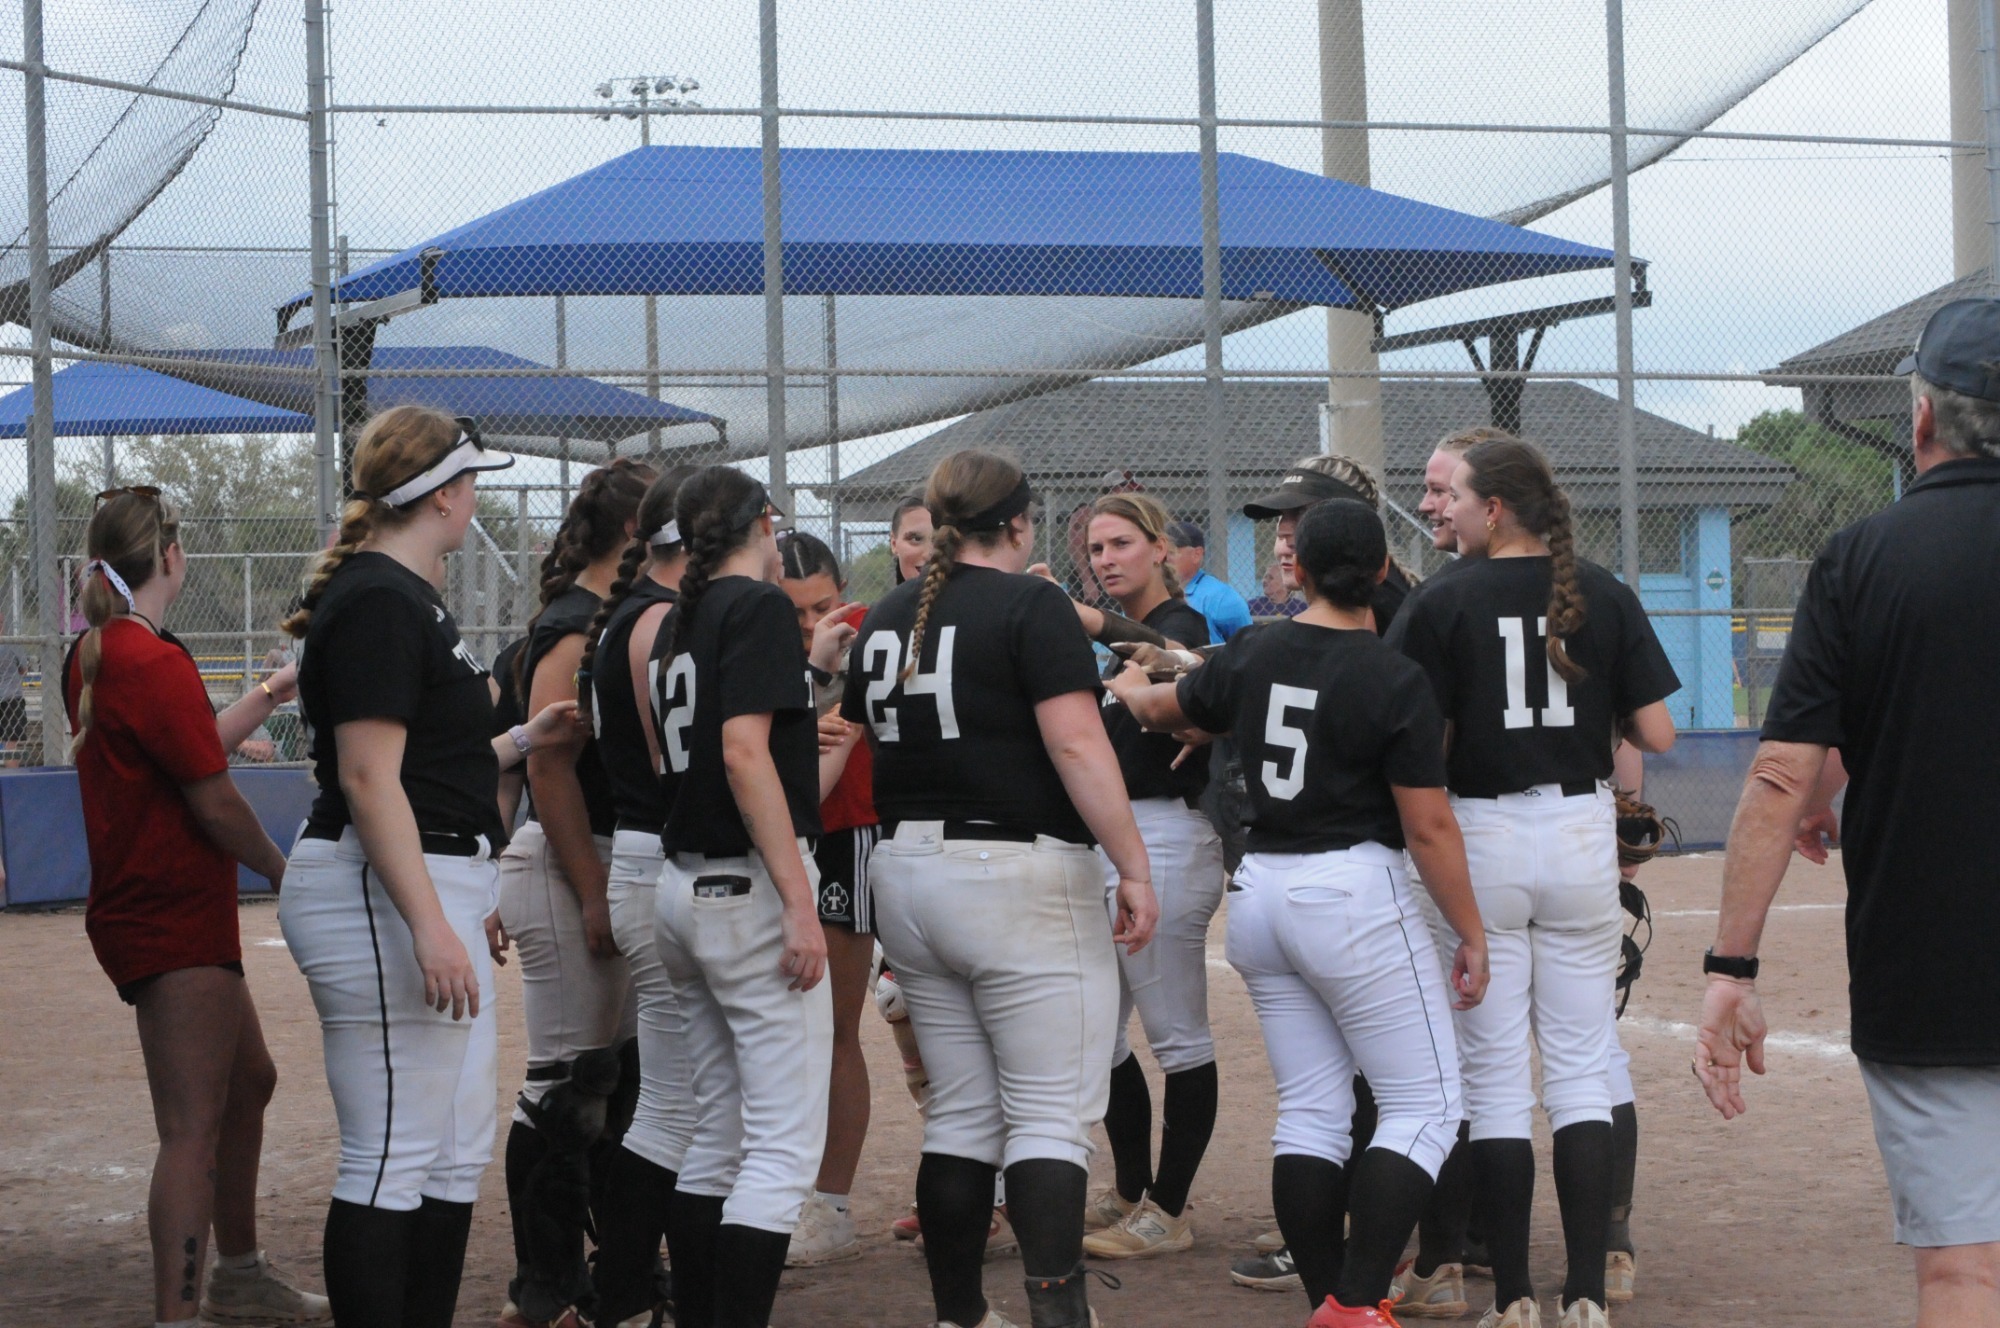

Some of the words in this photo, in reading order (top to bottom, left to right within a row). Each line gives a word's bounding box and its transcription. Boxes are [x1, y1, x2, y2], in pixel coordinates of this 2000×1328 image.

[863, 625, 960, 742] 24
[1498, 616, 1575, 729] 11
[1261, 683, 1319, 801] 5
[828, 896, 840, 910] T
